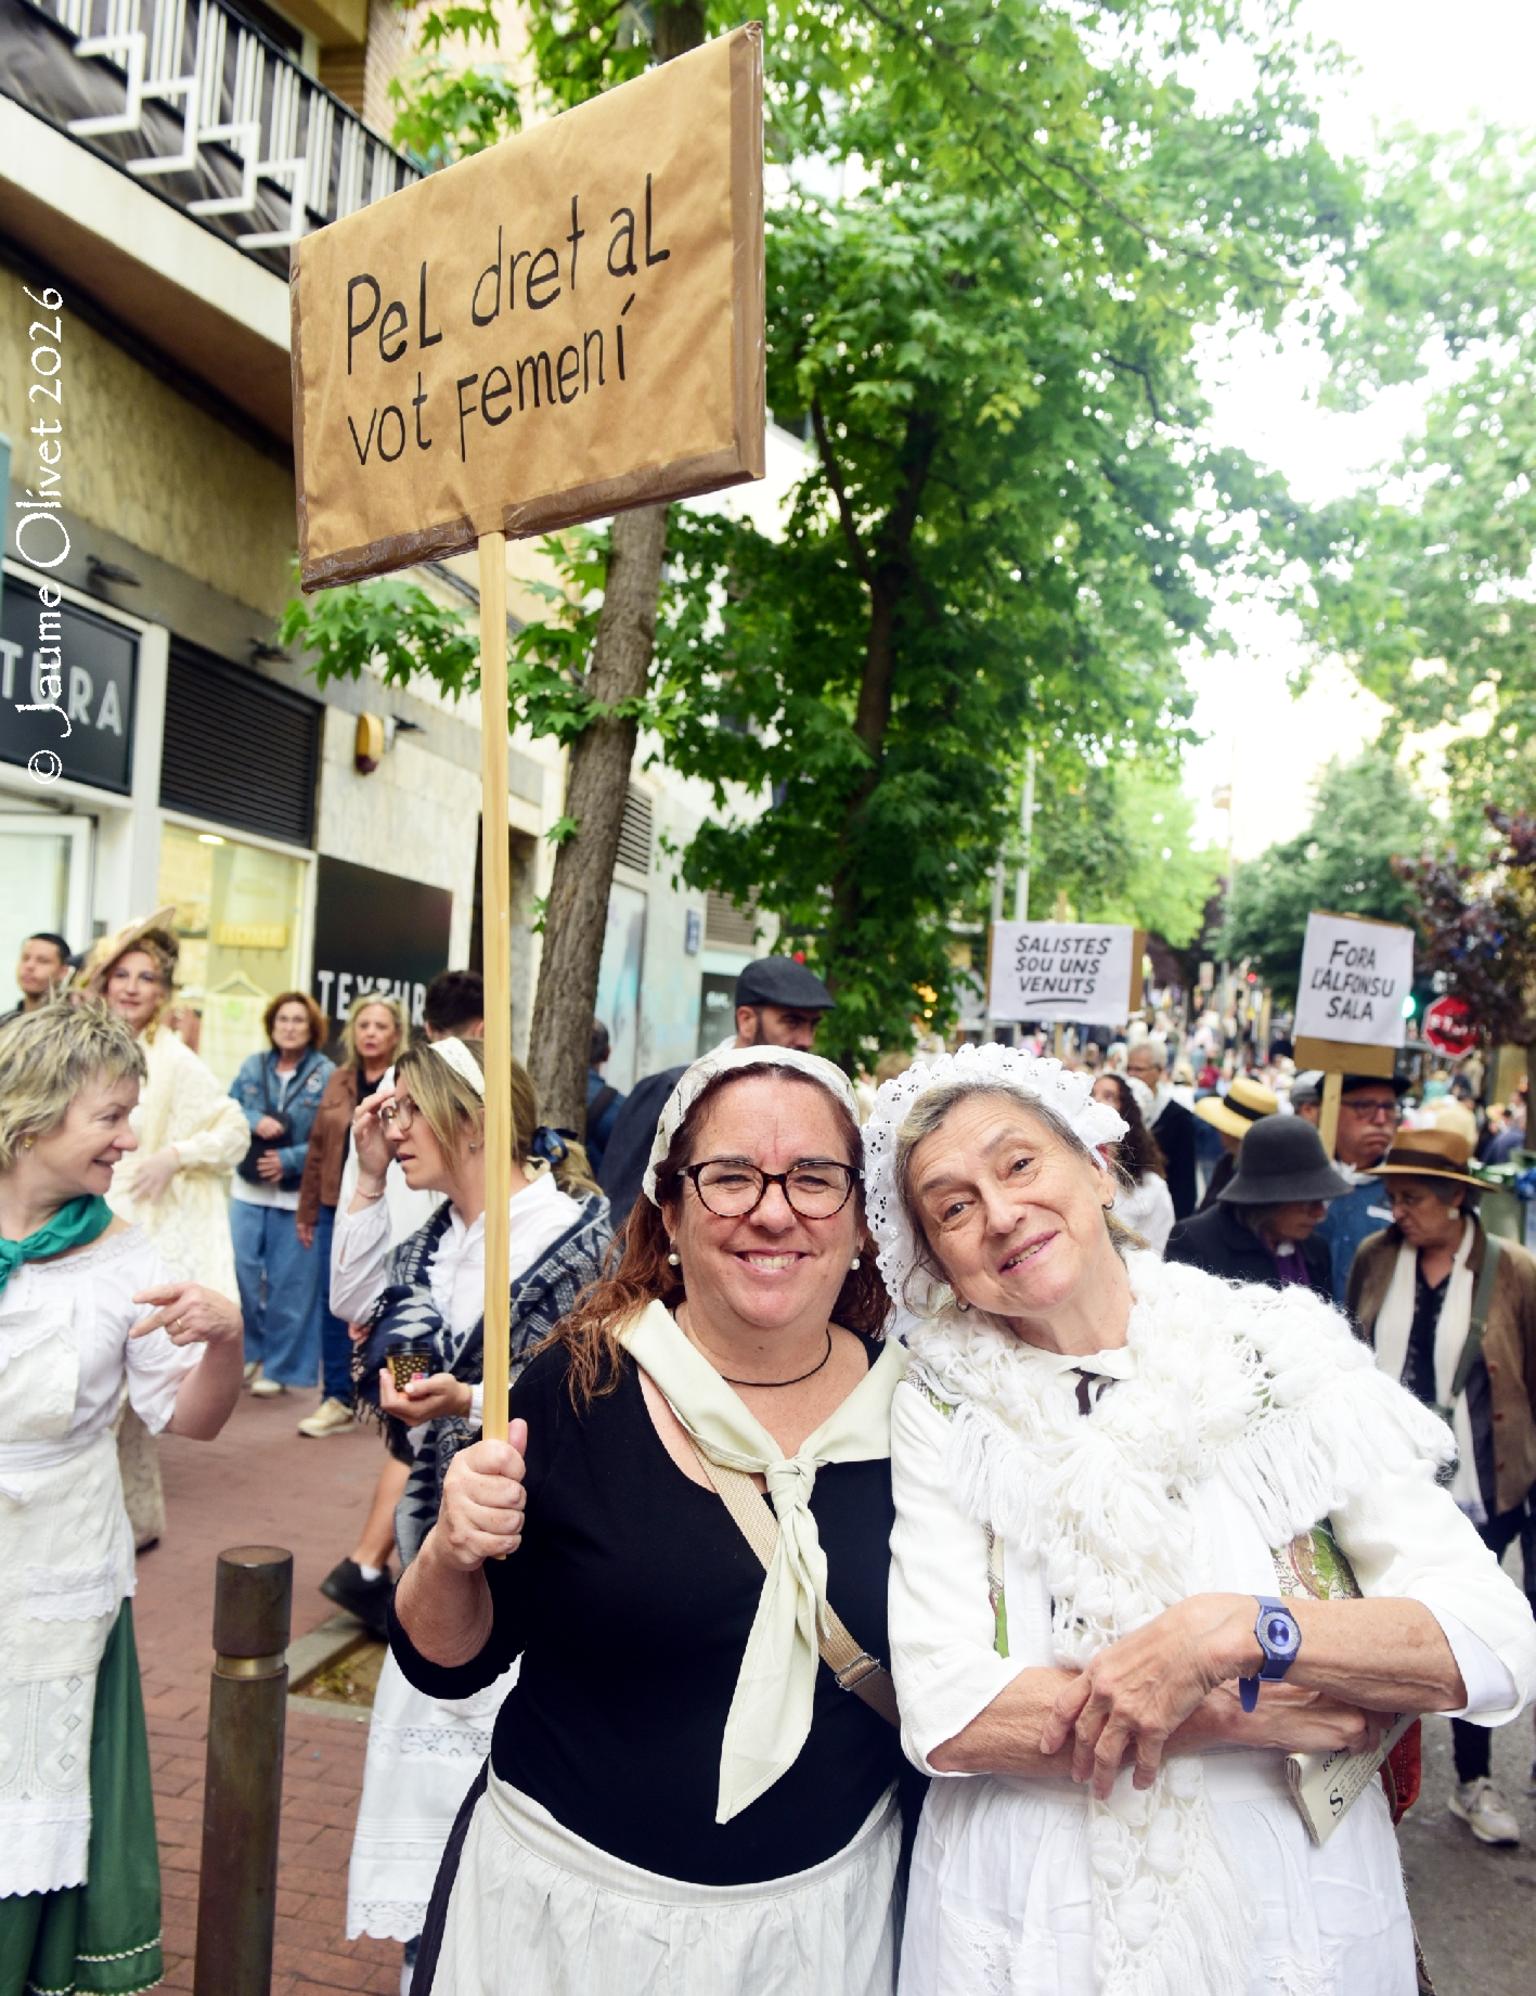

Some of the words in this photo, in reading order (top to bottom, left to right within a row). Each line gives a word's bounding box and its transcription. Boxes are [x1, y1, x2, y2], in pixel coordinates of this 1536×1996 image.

[471, 195, 585, 327] dret
[347, 371, 432, 466] vot
[0, 637, 123, 737] TURA
[1015, 933, 1113, 956] SALISTES
[1015, 956, 1054, 973] SOU
[1059, 958, 1101, 975] UNS
[1019, 975, 1096, 995] VENUTS
[1325, 996, 1374, 1022] SALA
